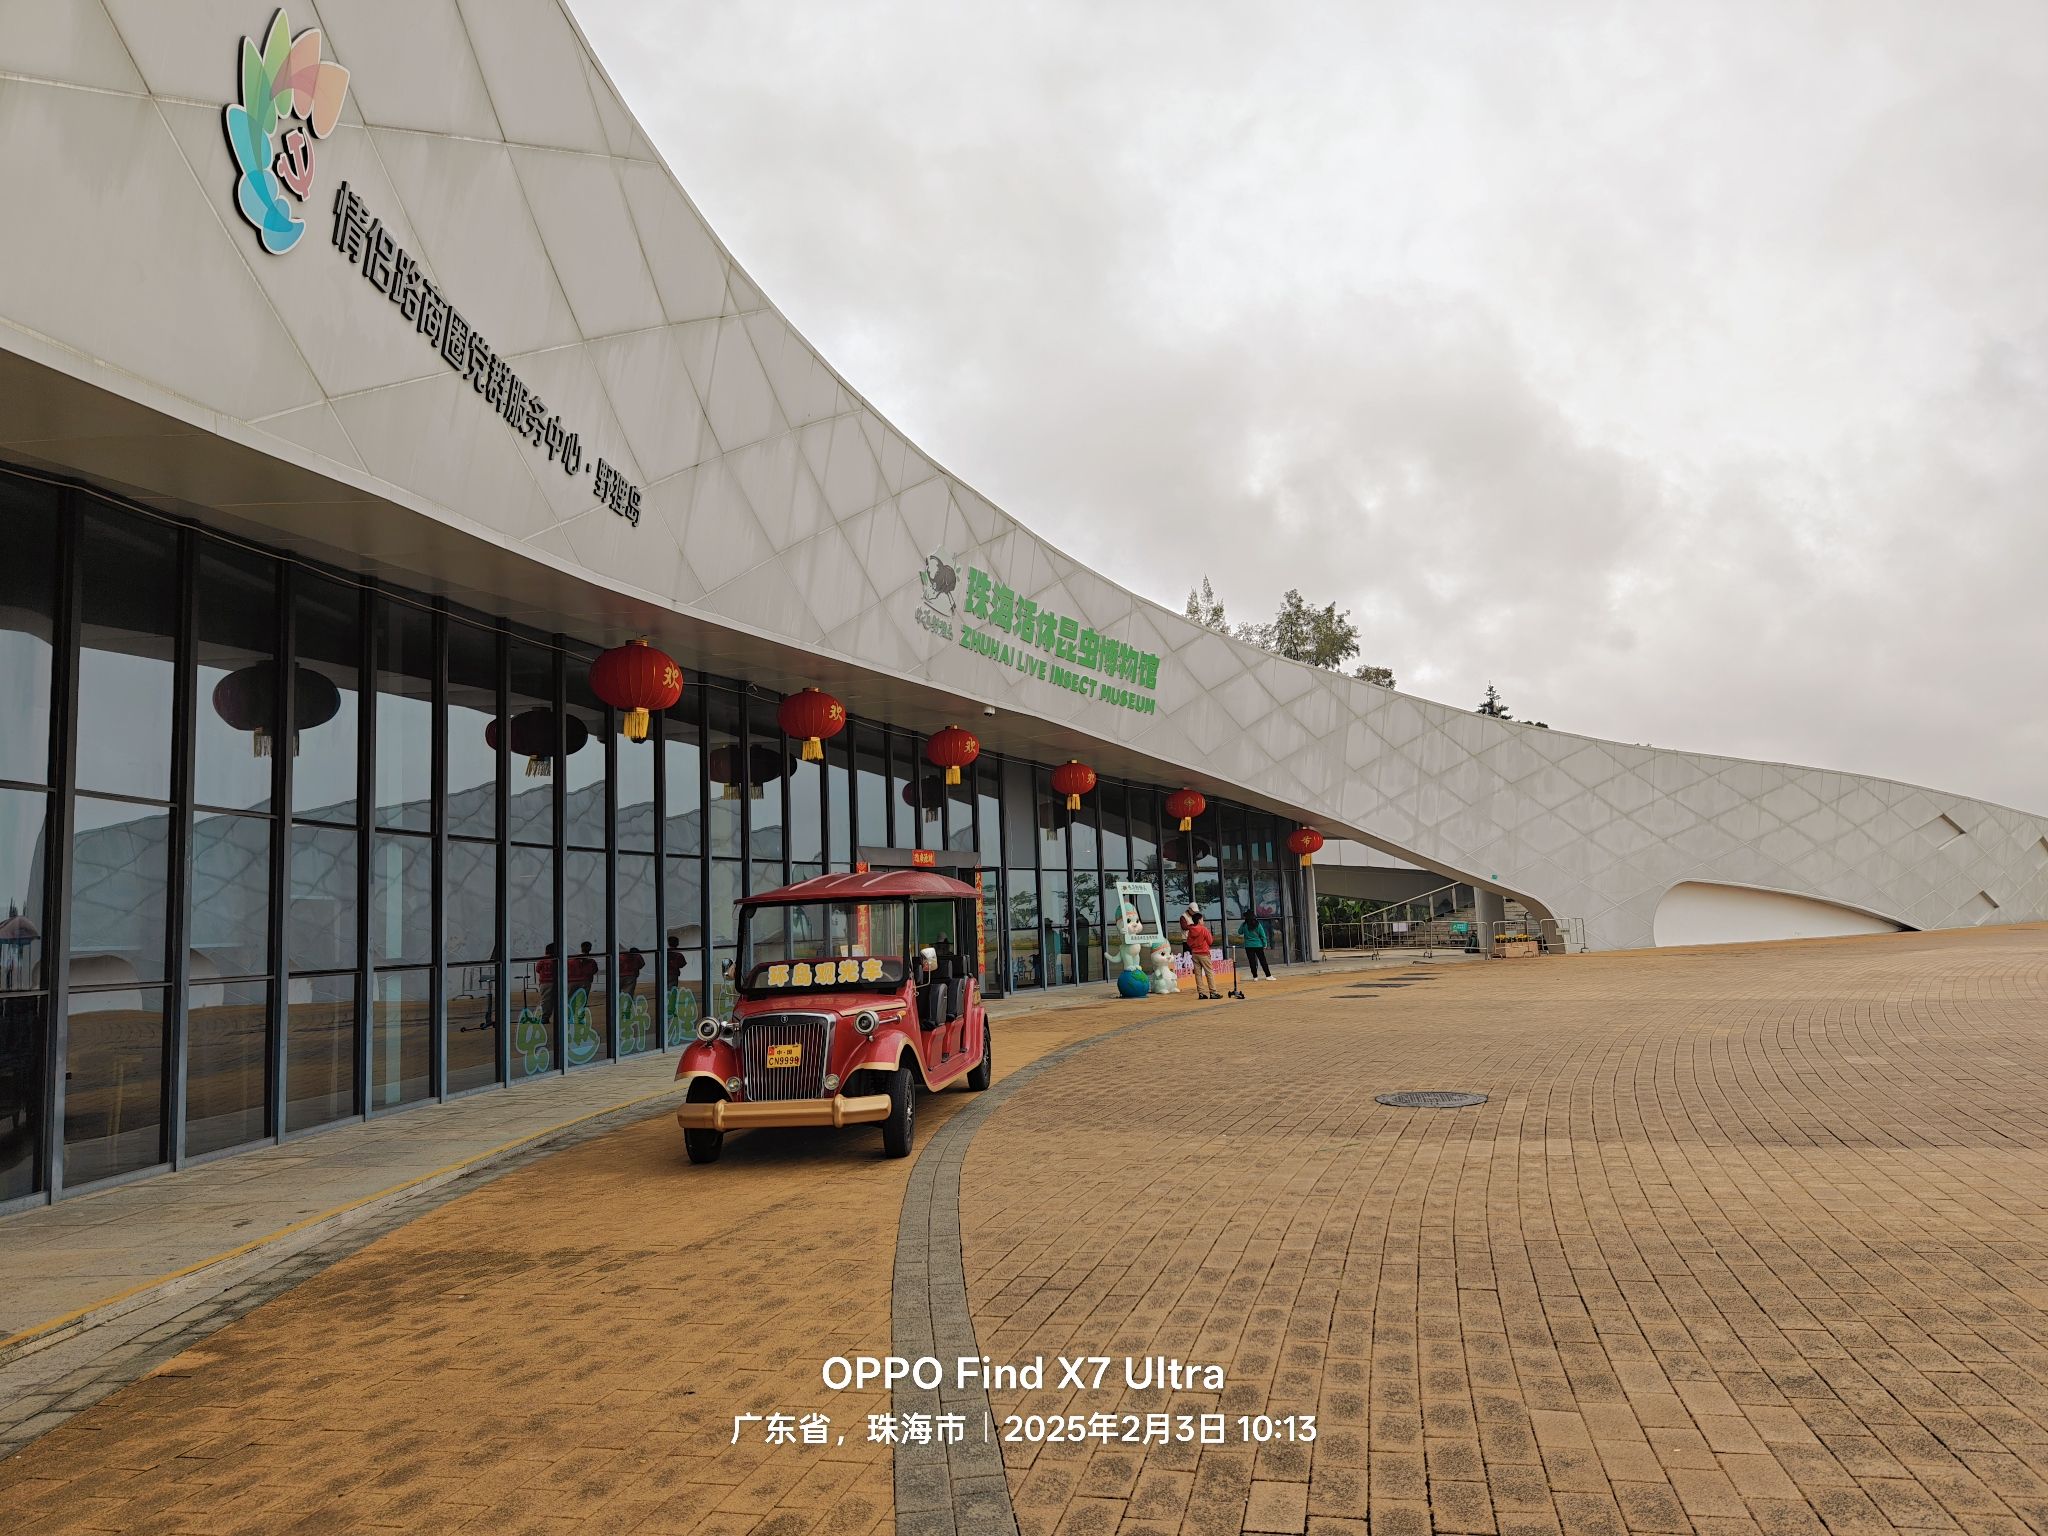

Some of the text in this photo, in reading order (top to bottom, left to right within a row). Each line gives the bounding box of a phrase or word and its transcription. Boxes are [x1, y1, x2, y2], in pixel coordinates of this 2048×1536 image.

[332, 180, 643, 527] 情侣路商圈党群服务中心·野狸岛
[959, 624, 1015, 667] ZHUHAI
[1017, 653, 1047, 681] LIVE
[1049, 664, 1097, 698] INSECT
[1099, 684, 1156, 715] MUSEUM
[963, 565, 1160, 690] 珠海活体昆虫博物馆
[768, 958, 883, 987] 环岛观光车
